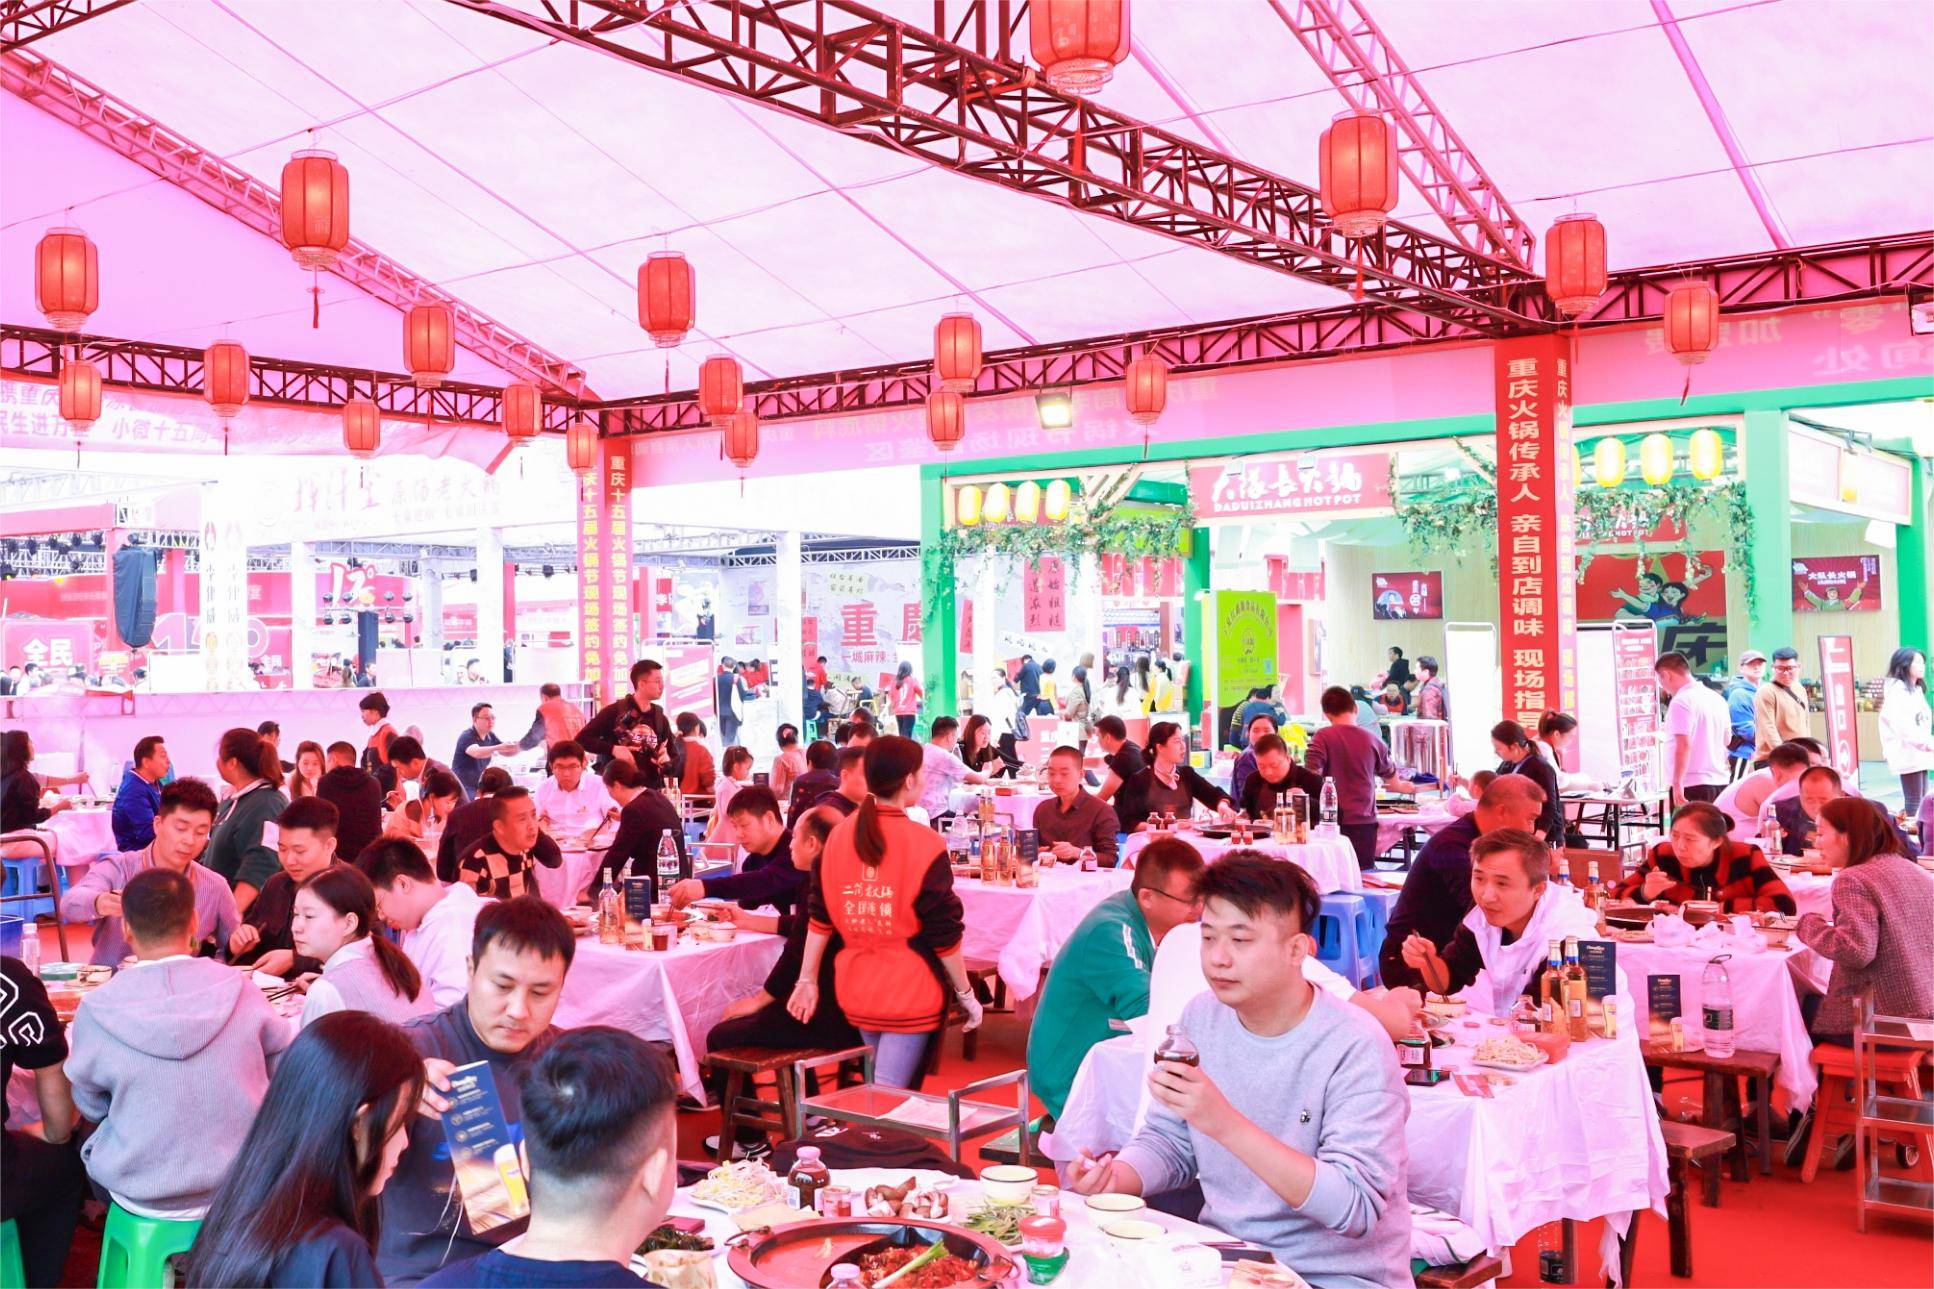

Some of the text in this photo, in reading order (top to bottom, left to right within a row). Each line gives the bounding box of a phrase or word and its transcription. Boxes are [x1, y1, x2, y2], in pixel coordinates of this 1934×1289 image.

[1507, 358, 1541, 503] 重庆火锅传承人
[1214, 494, 1362, 513] DADUIZHANG HOT POT
[1511, 513, 1545, 636] 亲自到店调味
[23, 638, 73, 666] 全民
